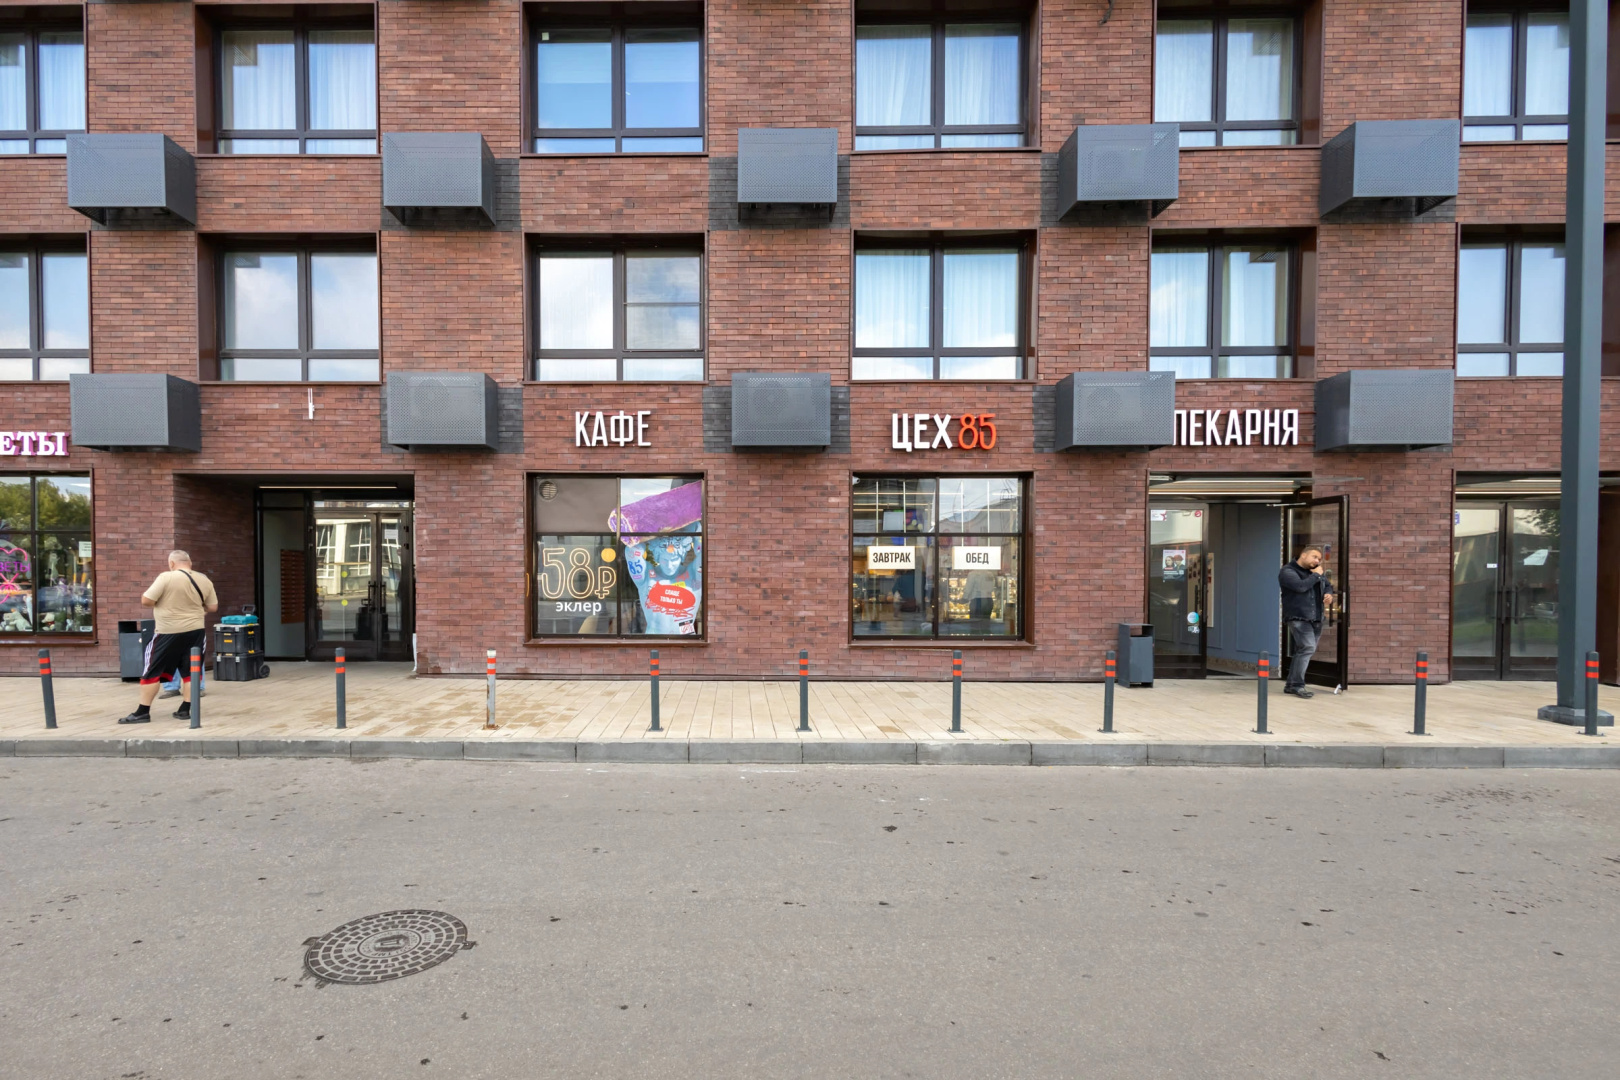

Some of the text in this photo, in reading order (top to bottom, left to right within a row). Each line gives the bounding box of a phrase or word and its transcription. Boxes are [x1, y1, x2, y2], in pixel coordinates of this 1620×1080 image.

[575, 410, 652, 447] КАФЕ
[892, 413, 997, 452] ЦЕХ 85
[1173, 409, 1299, 446] ПЕКАРНЯ
[873, 552, 911, 563] ЗАВТРАК
[965, 552, 990, 564] ОБЕД
[555, 601, 602, 615] эклер
